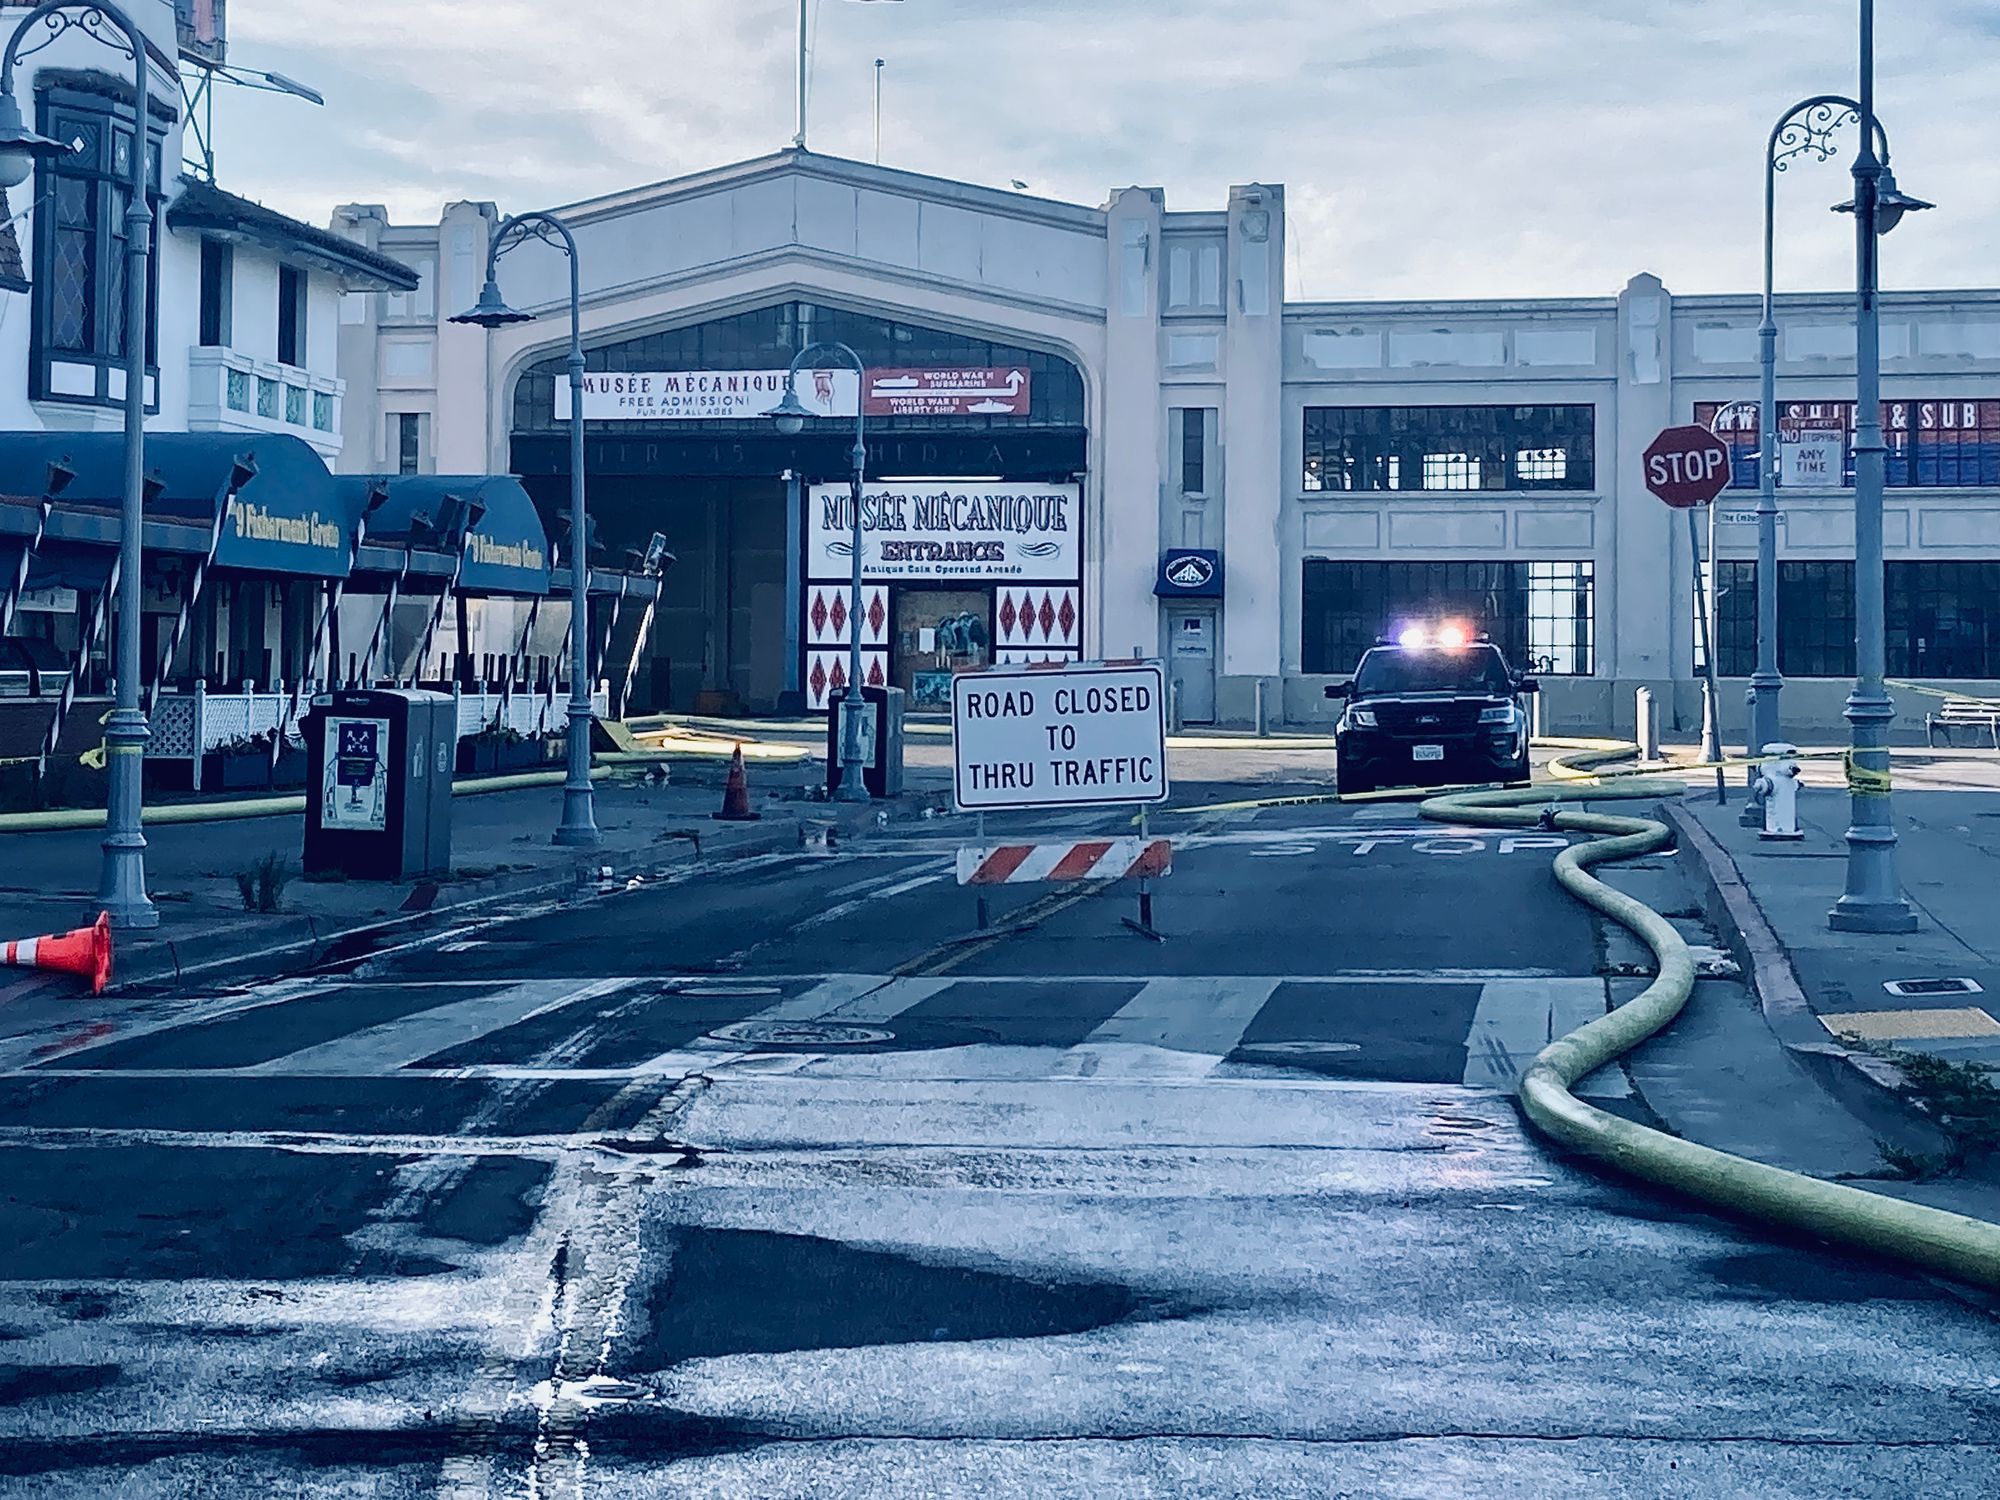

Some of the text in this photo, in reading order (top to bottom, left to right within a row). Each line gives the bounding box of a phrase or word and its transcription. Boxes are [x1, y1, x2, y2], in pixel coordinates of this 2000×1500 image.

[924, 372, 959, 381] WORLD
[962, 372, 984, 380] WAR
[583, 373, 793, 394] MUSÉE MÉCANIQUE
[930, 380, 986, 388] SUBMARINE
[619, 394, 750, 407] FREE ADMISSION!
[890, 398, 925, 406] WORLD
[928, 398, 950, 406] WAR
[636, 407, 733, 417] FUN FOR ALL AGES
[893, 406, 956, 414] LIBERTY SHIP
[1892, 404, 1906, 428] &
[1922, 403, 1976, 428] SUB
[1781, 430, 1799, 442] NO
[1798, 449, 1825, 459] ANY
[1650, 448, 1723, 486] STOP
[1796, 461, 1826, 472] TIME
[821, 491, 1068, 533] MUSÉE MÉCANIQUE
[881, 541, 1005, 562] ENTRANCE
[863, 564, 1022, 575] Antique Coin Operated Arcade
[967, 686, 1150, 719] ROAD CLOSED
[1045, 724, 1076, 751] TO
[968, 757, 1154, 790] THRU TRAFFIC
[1250, 838, 1569, 857] STOP
